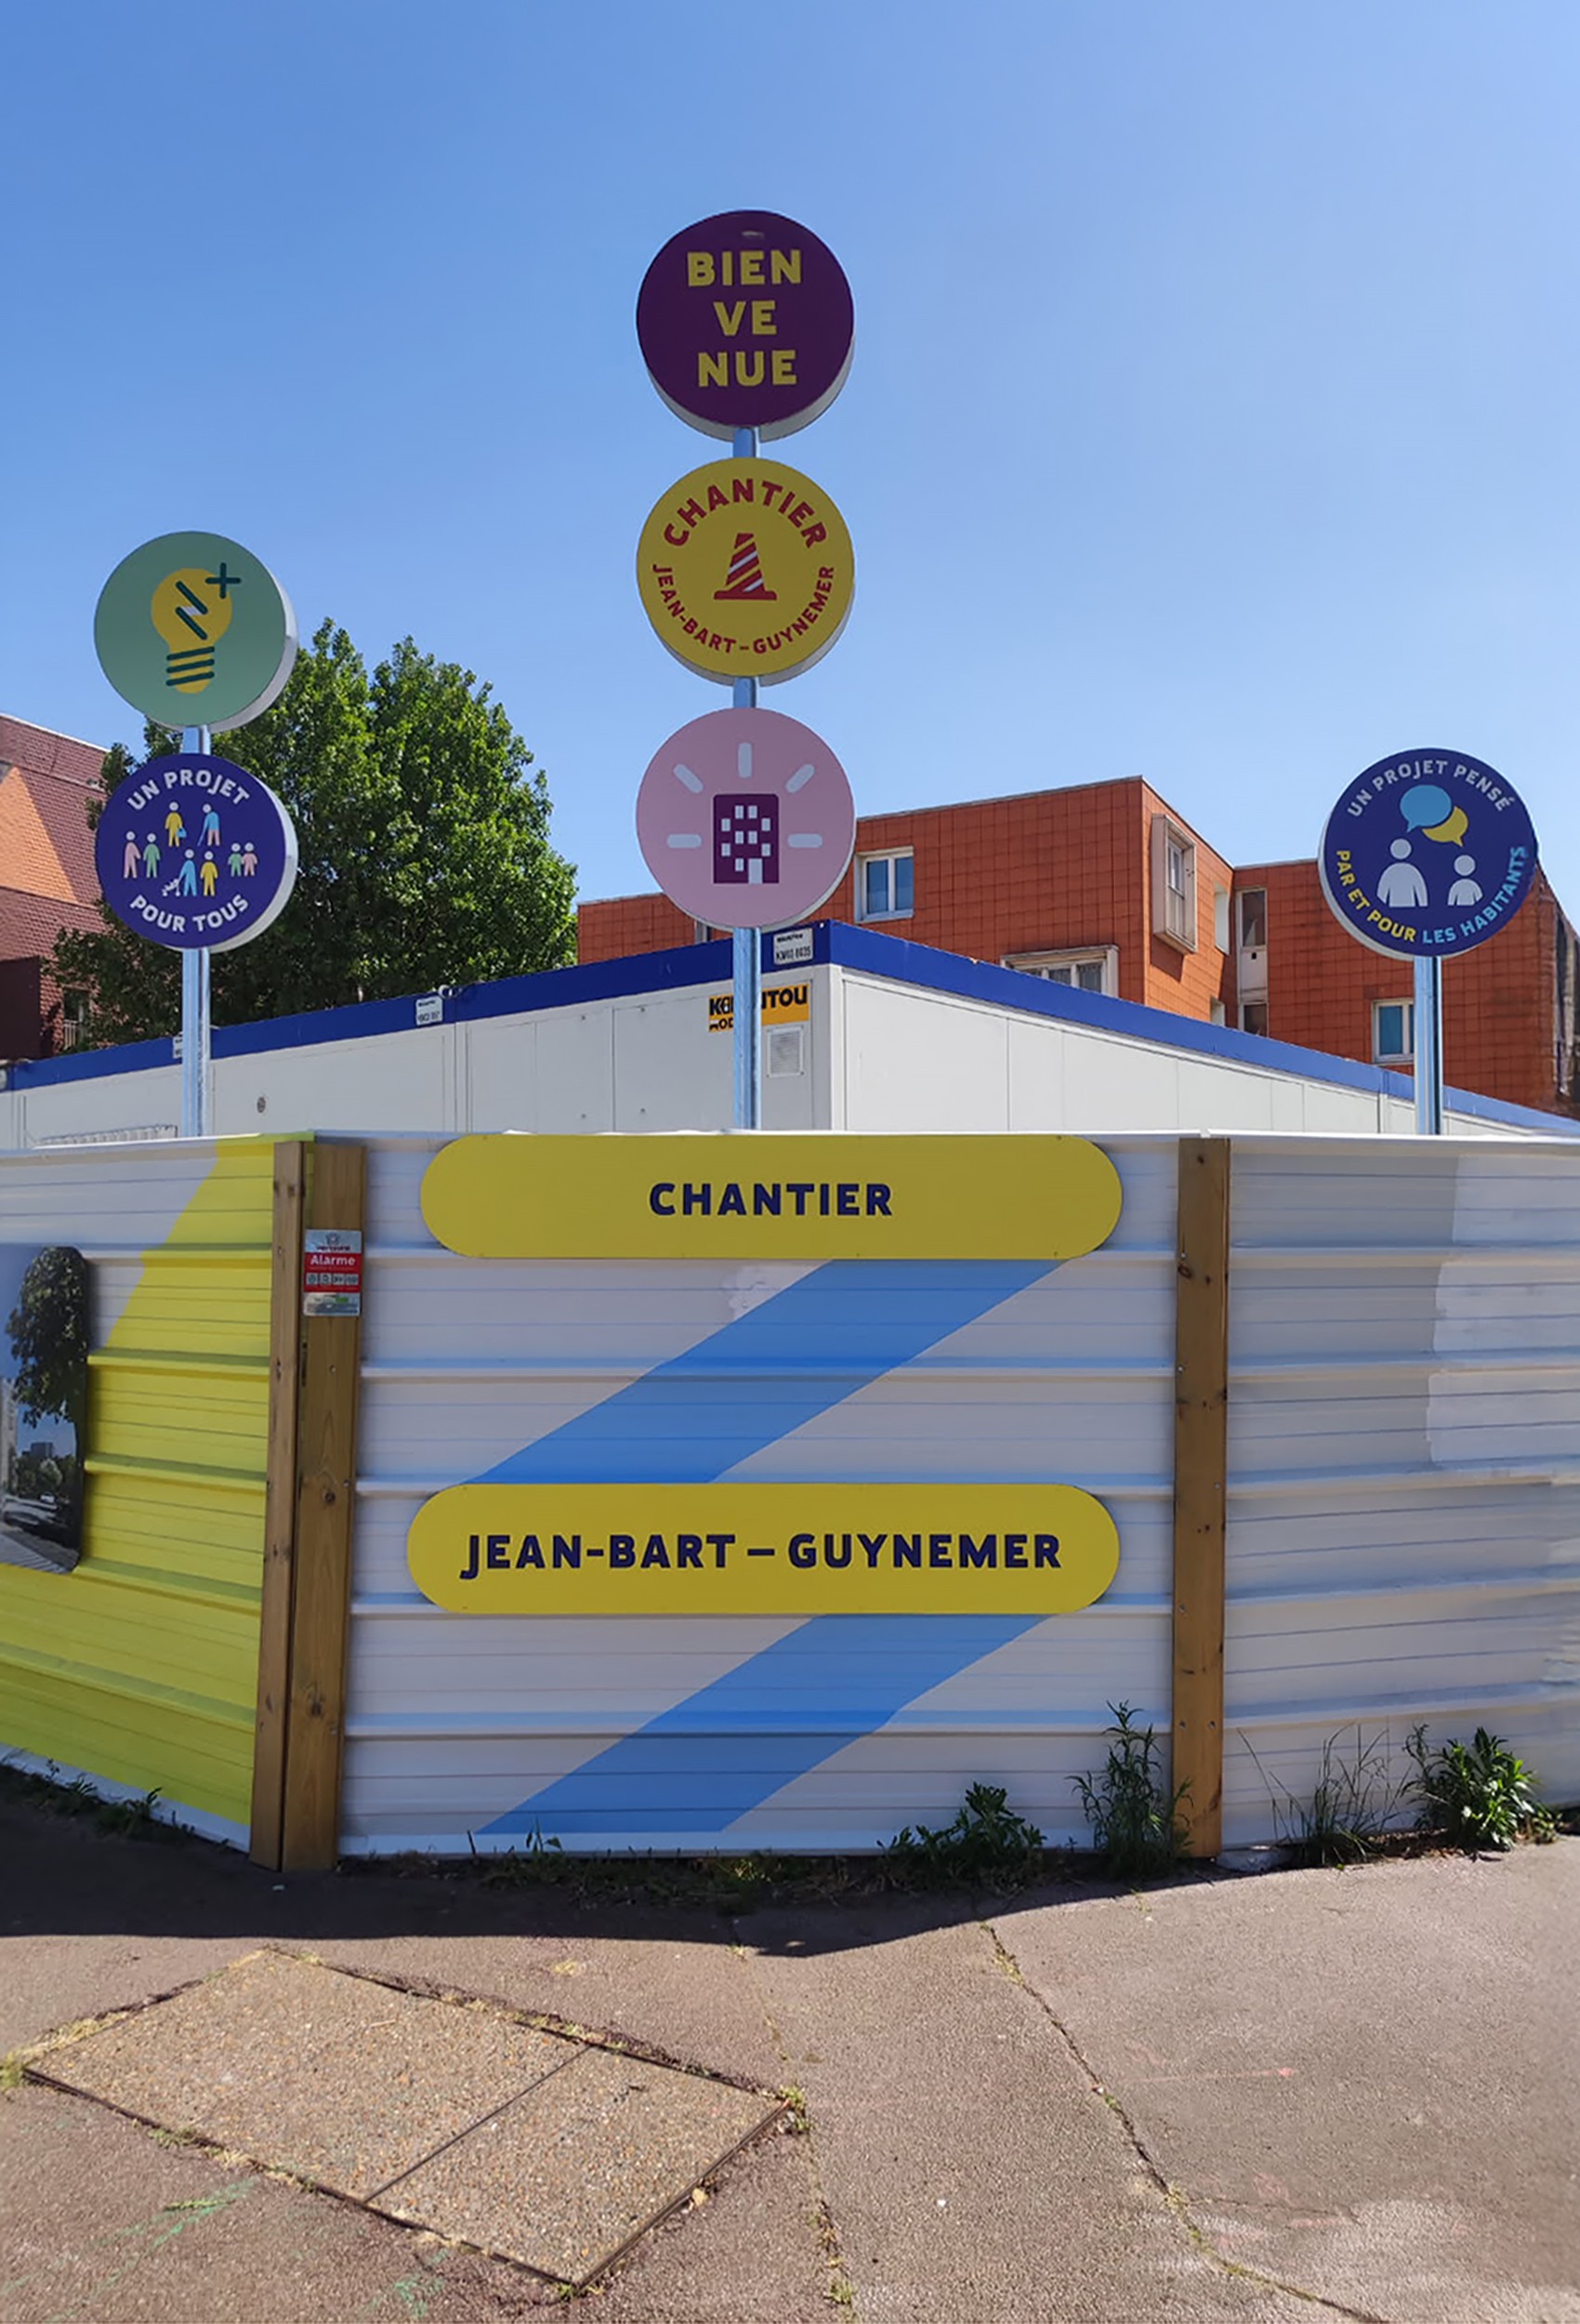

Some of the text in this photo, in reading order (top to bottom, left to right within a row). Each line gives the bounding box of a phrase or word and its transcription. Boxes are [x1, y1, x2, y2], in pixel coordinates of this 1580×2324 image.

[687, 249, 801, 286] BIEN
[714, 300, 777, 337] VE
[698, 350, 797, 388] NUE
[664, 478, 828, 548] CHANTIER
[652, 563, 737, 654] JEAN-BART
[752, 565, 835, 654] GUYNEMER
[126, 769, 250, 811] UN PROJET
[1347, 759, 1515, 818] UN PROJET PENSÉ
[129, 893, 249, 933] POUR TOUS
[1336, 846, 1529, 944] PAR ET POUR LES HABITANTS
[649, 1182, 892, 1216] CHANTIER
[310, 1254, 355, 1265] Alarme
[460, 1534, 736, 1579] JEAN-BART
[788, 1533, 1061, 1569] GUYNEMER
